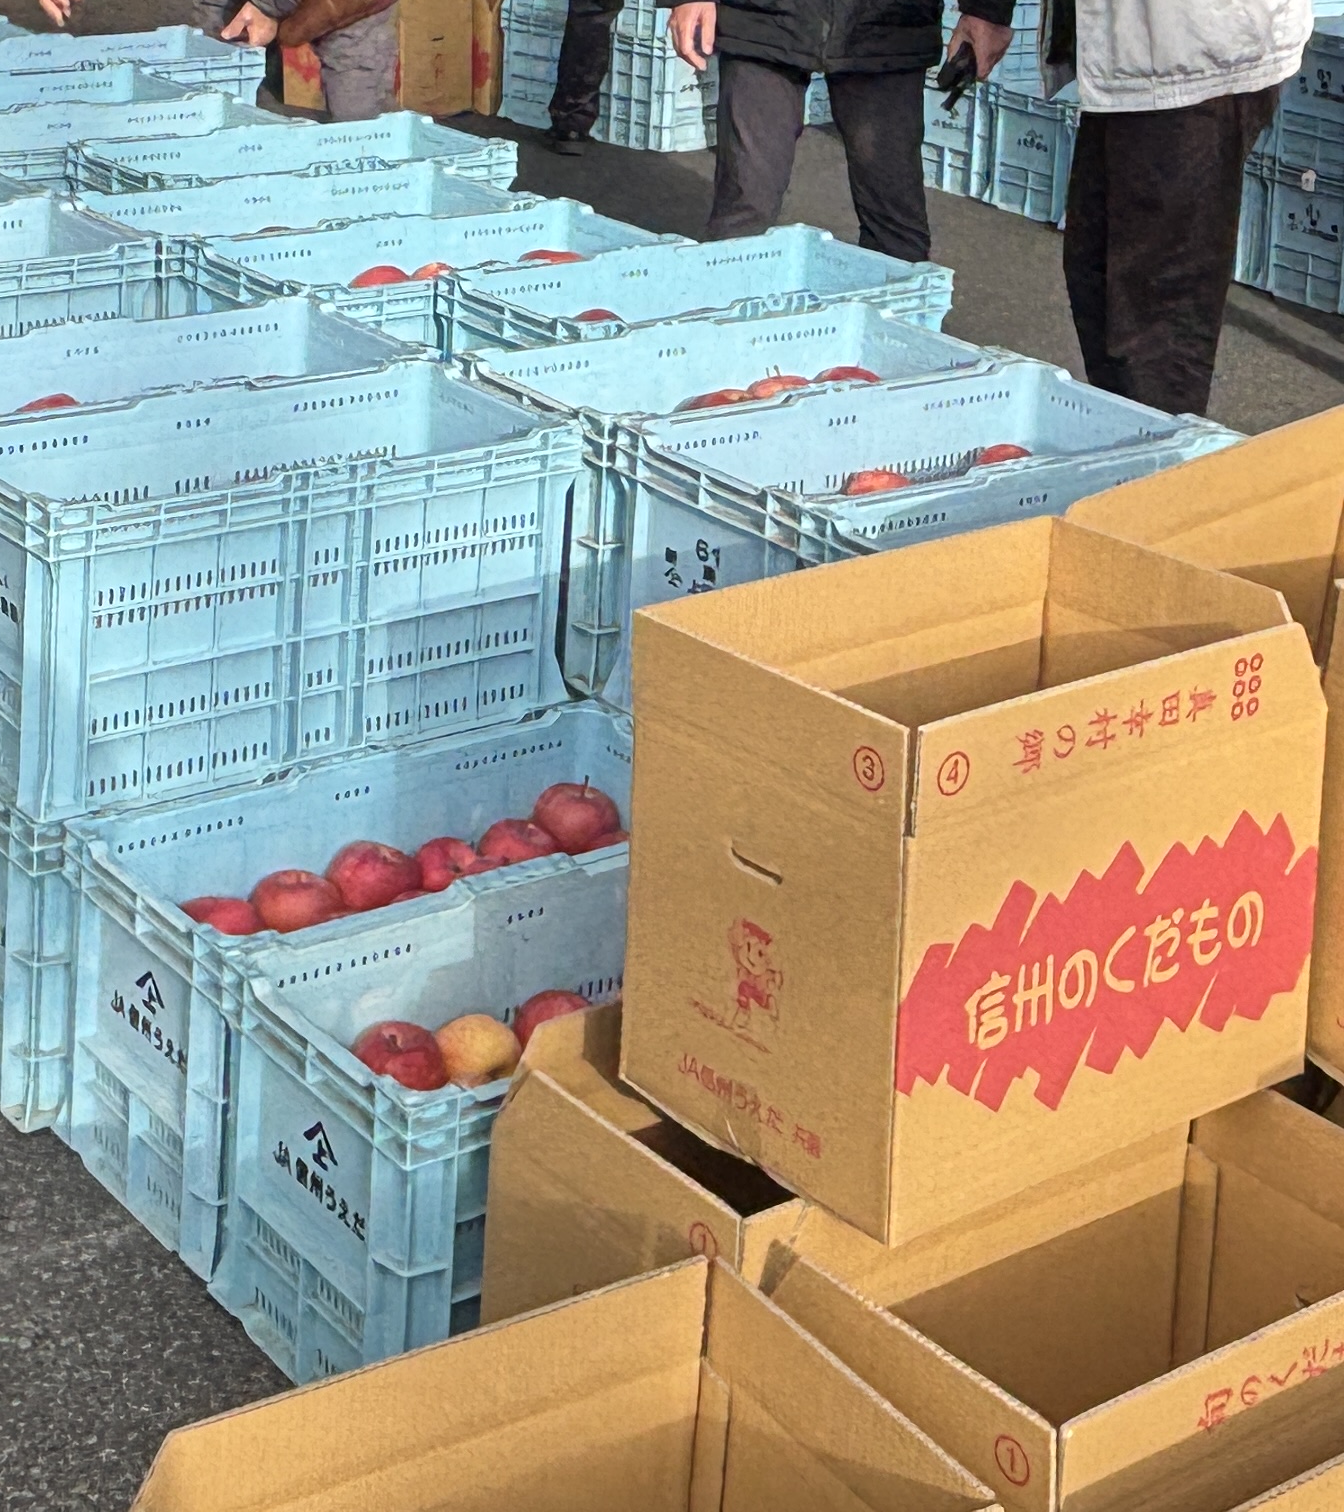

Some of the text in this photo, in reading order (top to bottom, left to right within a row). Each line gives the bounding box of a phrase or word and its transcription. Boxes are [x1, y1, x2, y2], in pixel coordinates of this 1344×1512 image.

[964, 889, 1265, 1051] 信州のくだもの
